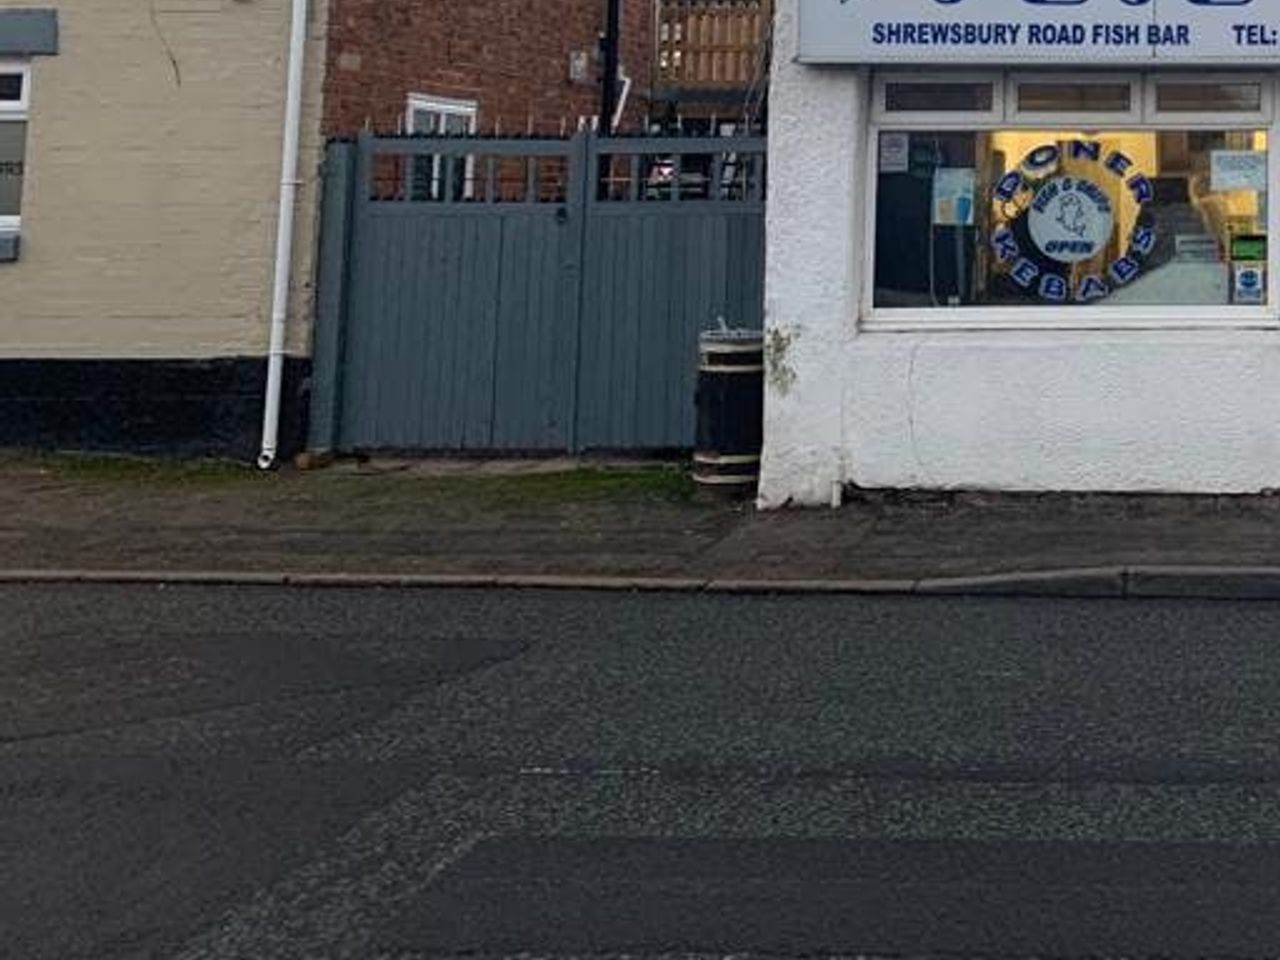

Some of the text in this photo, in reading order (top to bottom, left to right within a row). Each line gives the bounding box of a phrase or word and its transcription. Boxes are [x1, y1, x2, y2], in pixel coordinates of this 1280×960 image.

[872, 23, 1022, 46] SHREWSBURY
[1027, 23, 1086, 46] ROAD
[1091, 23, 1140, 46] FISH
[1147, 23, 1190, 46] BAR
[1232, 24, 1278, 46] TEL:
[996, 140, 1153, 204] DONER
[993, 225, 1156, 302] KEBABS
[1045, 240, 1095, 253] OPEN
